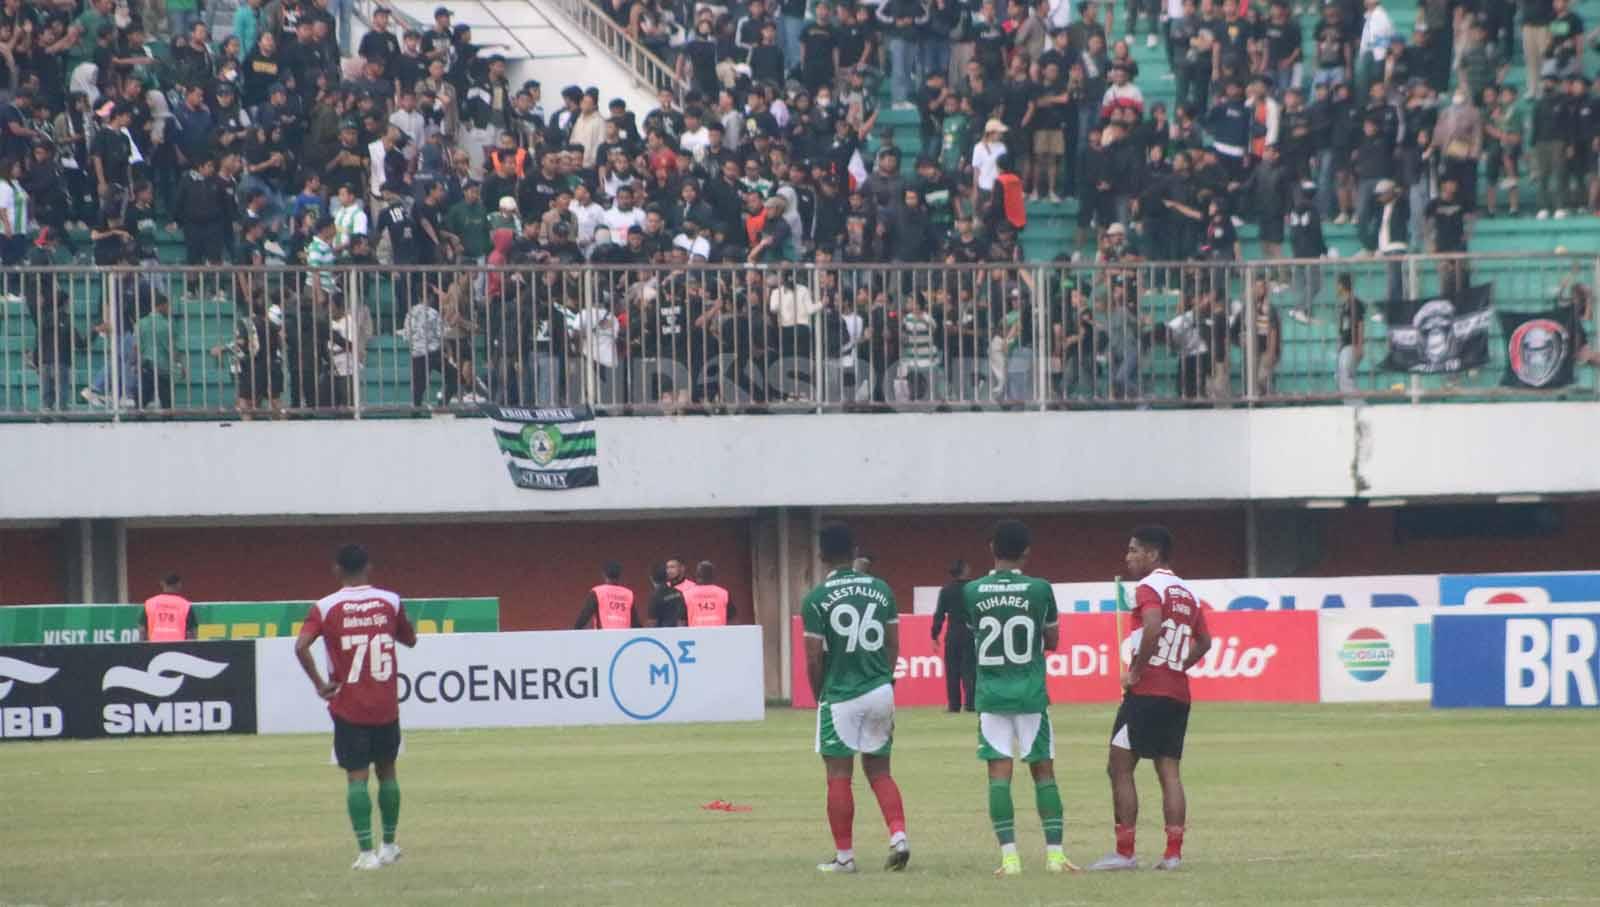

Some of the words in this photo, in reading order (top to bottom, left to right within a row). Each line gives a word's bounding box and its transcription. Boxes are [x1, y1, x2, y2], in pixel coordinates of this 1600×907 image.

[975, 595, 1030, 612] TUHAREA
[44, 628, 89, 645] VISIT
[830, 603, 884, 652] 96
[978, 616, 1035, 666] 20
[341, 633, 394, 684] 76
[0, 705, 63, 738] BD
[103, 700, 232, 735] SMBD
